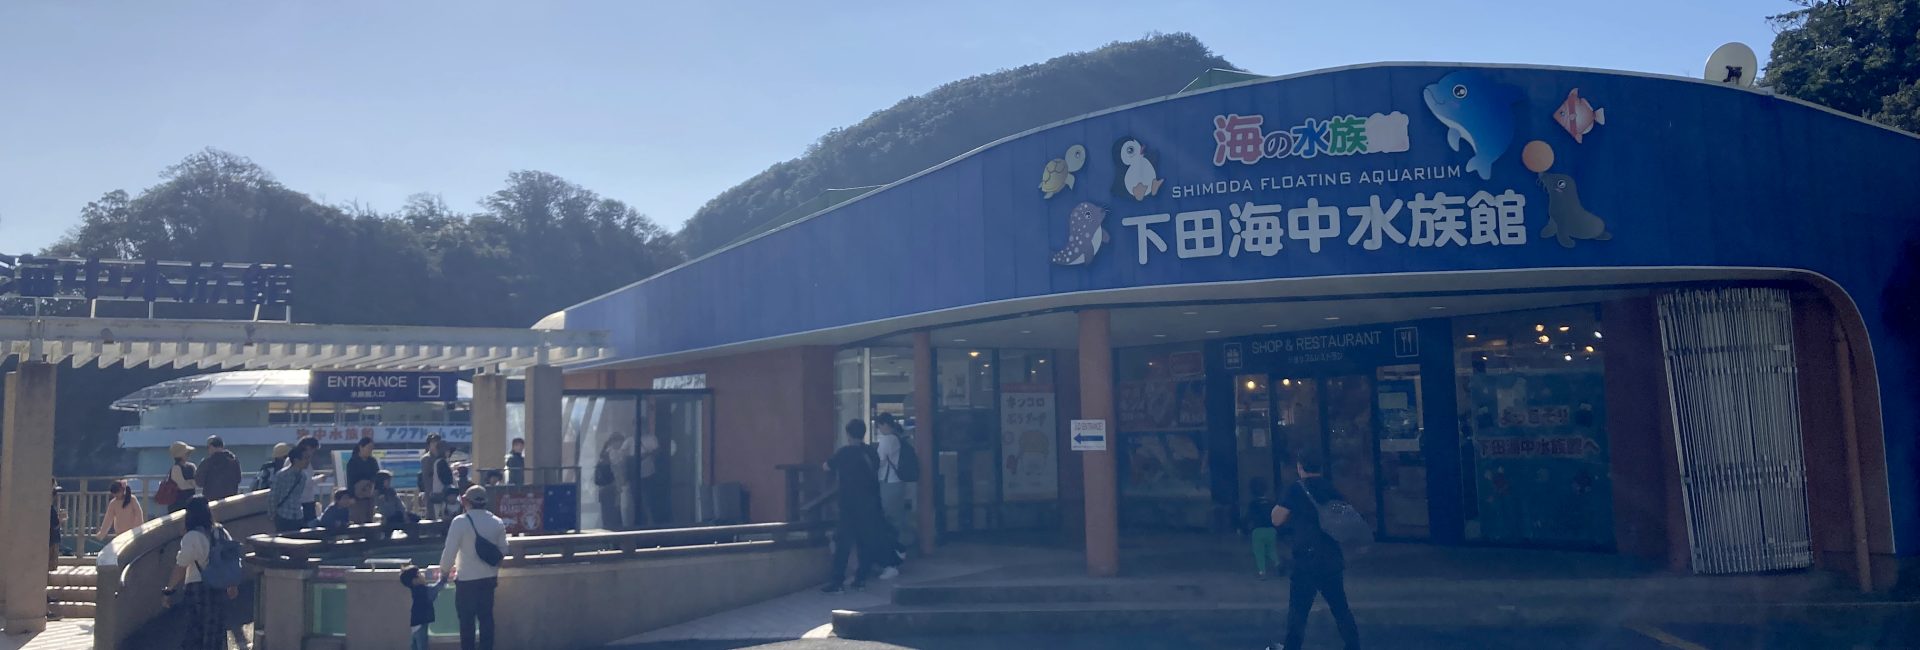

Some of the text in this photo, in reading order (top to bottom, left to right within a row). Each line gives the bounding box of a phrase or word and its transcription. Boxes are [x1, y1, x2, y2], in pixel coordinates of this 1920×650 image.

[1172, 164, 1463, 199] SHIMODA FLOATING AQUARIUM
[1121, 189, 1528, 265] 下田海中水族館
[1252, 331, 1383, 355] SHOP & RESTAURANT
[327, 376, 408, 388] ENTRANCE
